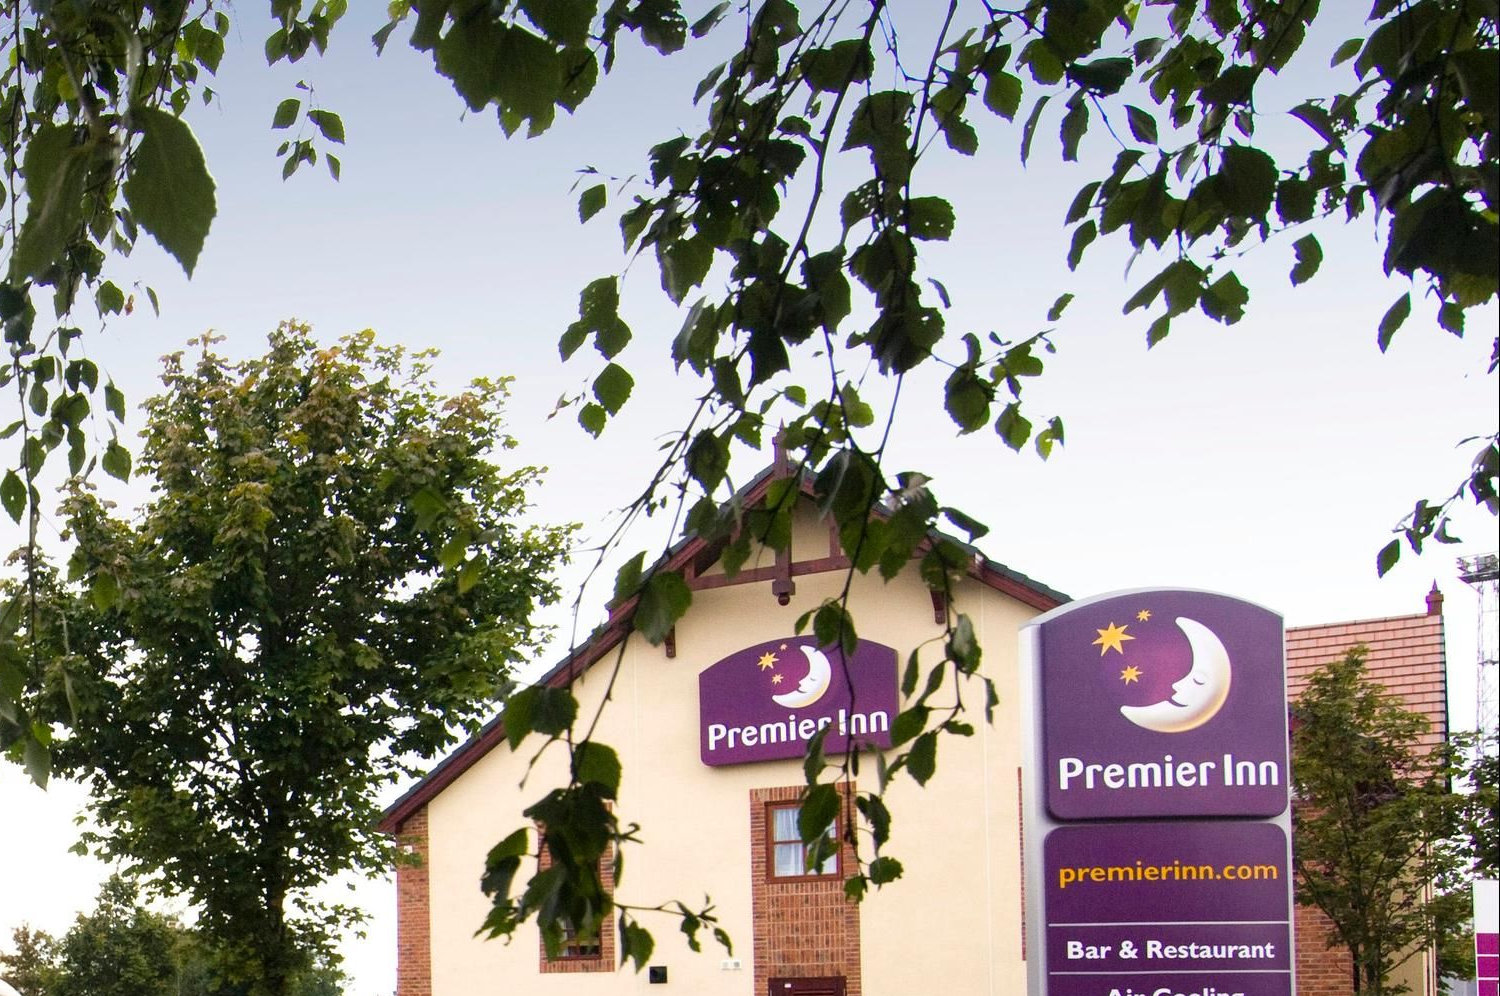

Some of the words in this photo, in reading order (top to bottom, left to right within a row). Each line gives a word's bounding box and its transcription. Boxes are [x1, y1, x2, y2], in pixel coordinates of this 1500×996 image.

[708, 715, 832, 751] Premier
[838, 709, 888, 736] Inn
[1059, 754, 1216, 790] Premier
[1223, 754, 1279, 786] Inn
[1059, 861, 1278, 889] premierinn.com
[1067, 940, 1112, 960] Bar
[1118, 940, 1139, 959] &
[1146, 940, 1275, 959] Restaurant
